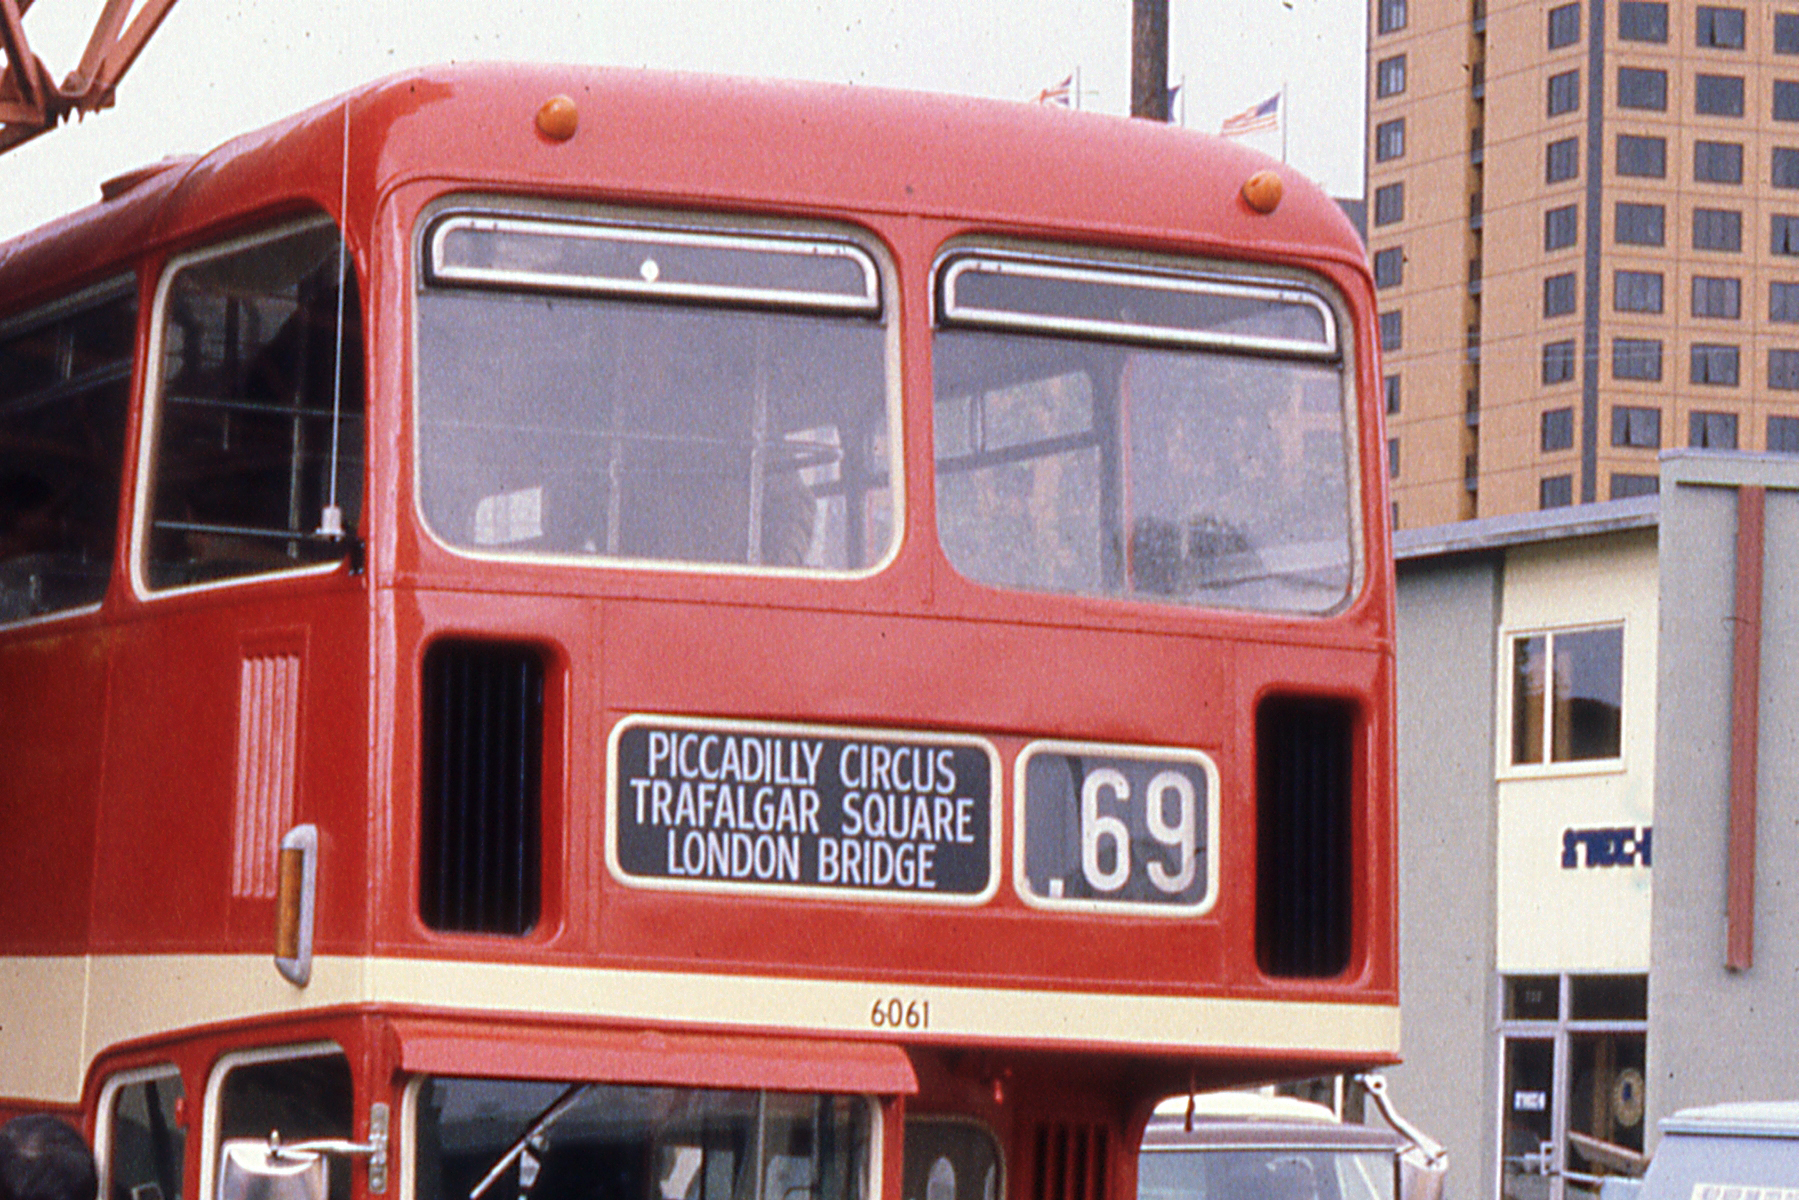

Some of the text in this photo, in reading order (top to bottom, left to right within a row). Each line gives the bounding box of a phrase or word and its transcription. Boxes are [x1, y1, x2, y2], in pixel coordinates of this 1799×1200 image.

[649, 731, 957, 794] PICCADILLY CIRCUS
[630, 778, 975, 843] TRAFALGAR SQUARE
[1081, 767, 1197, 893] 69
[667, 829, 938, 888] LONDON BRIDGE
[870, 997, 929, 1029] 6061
